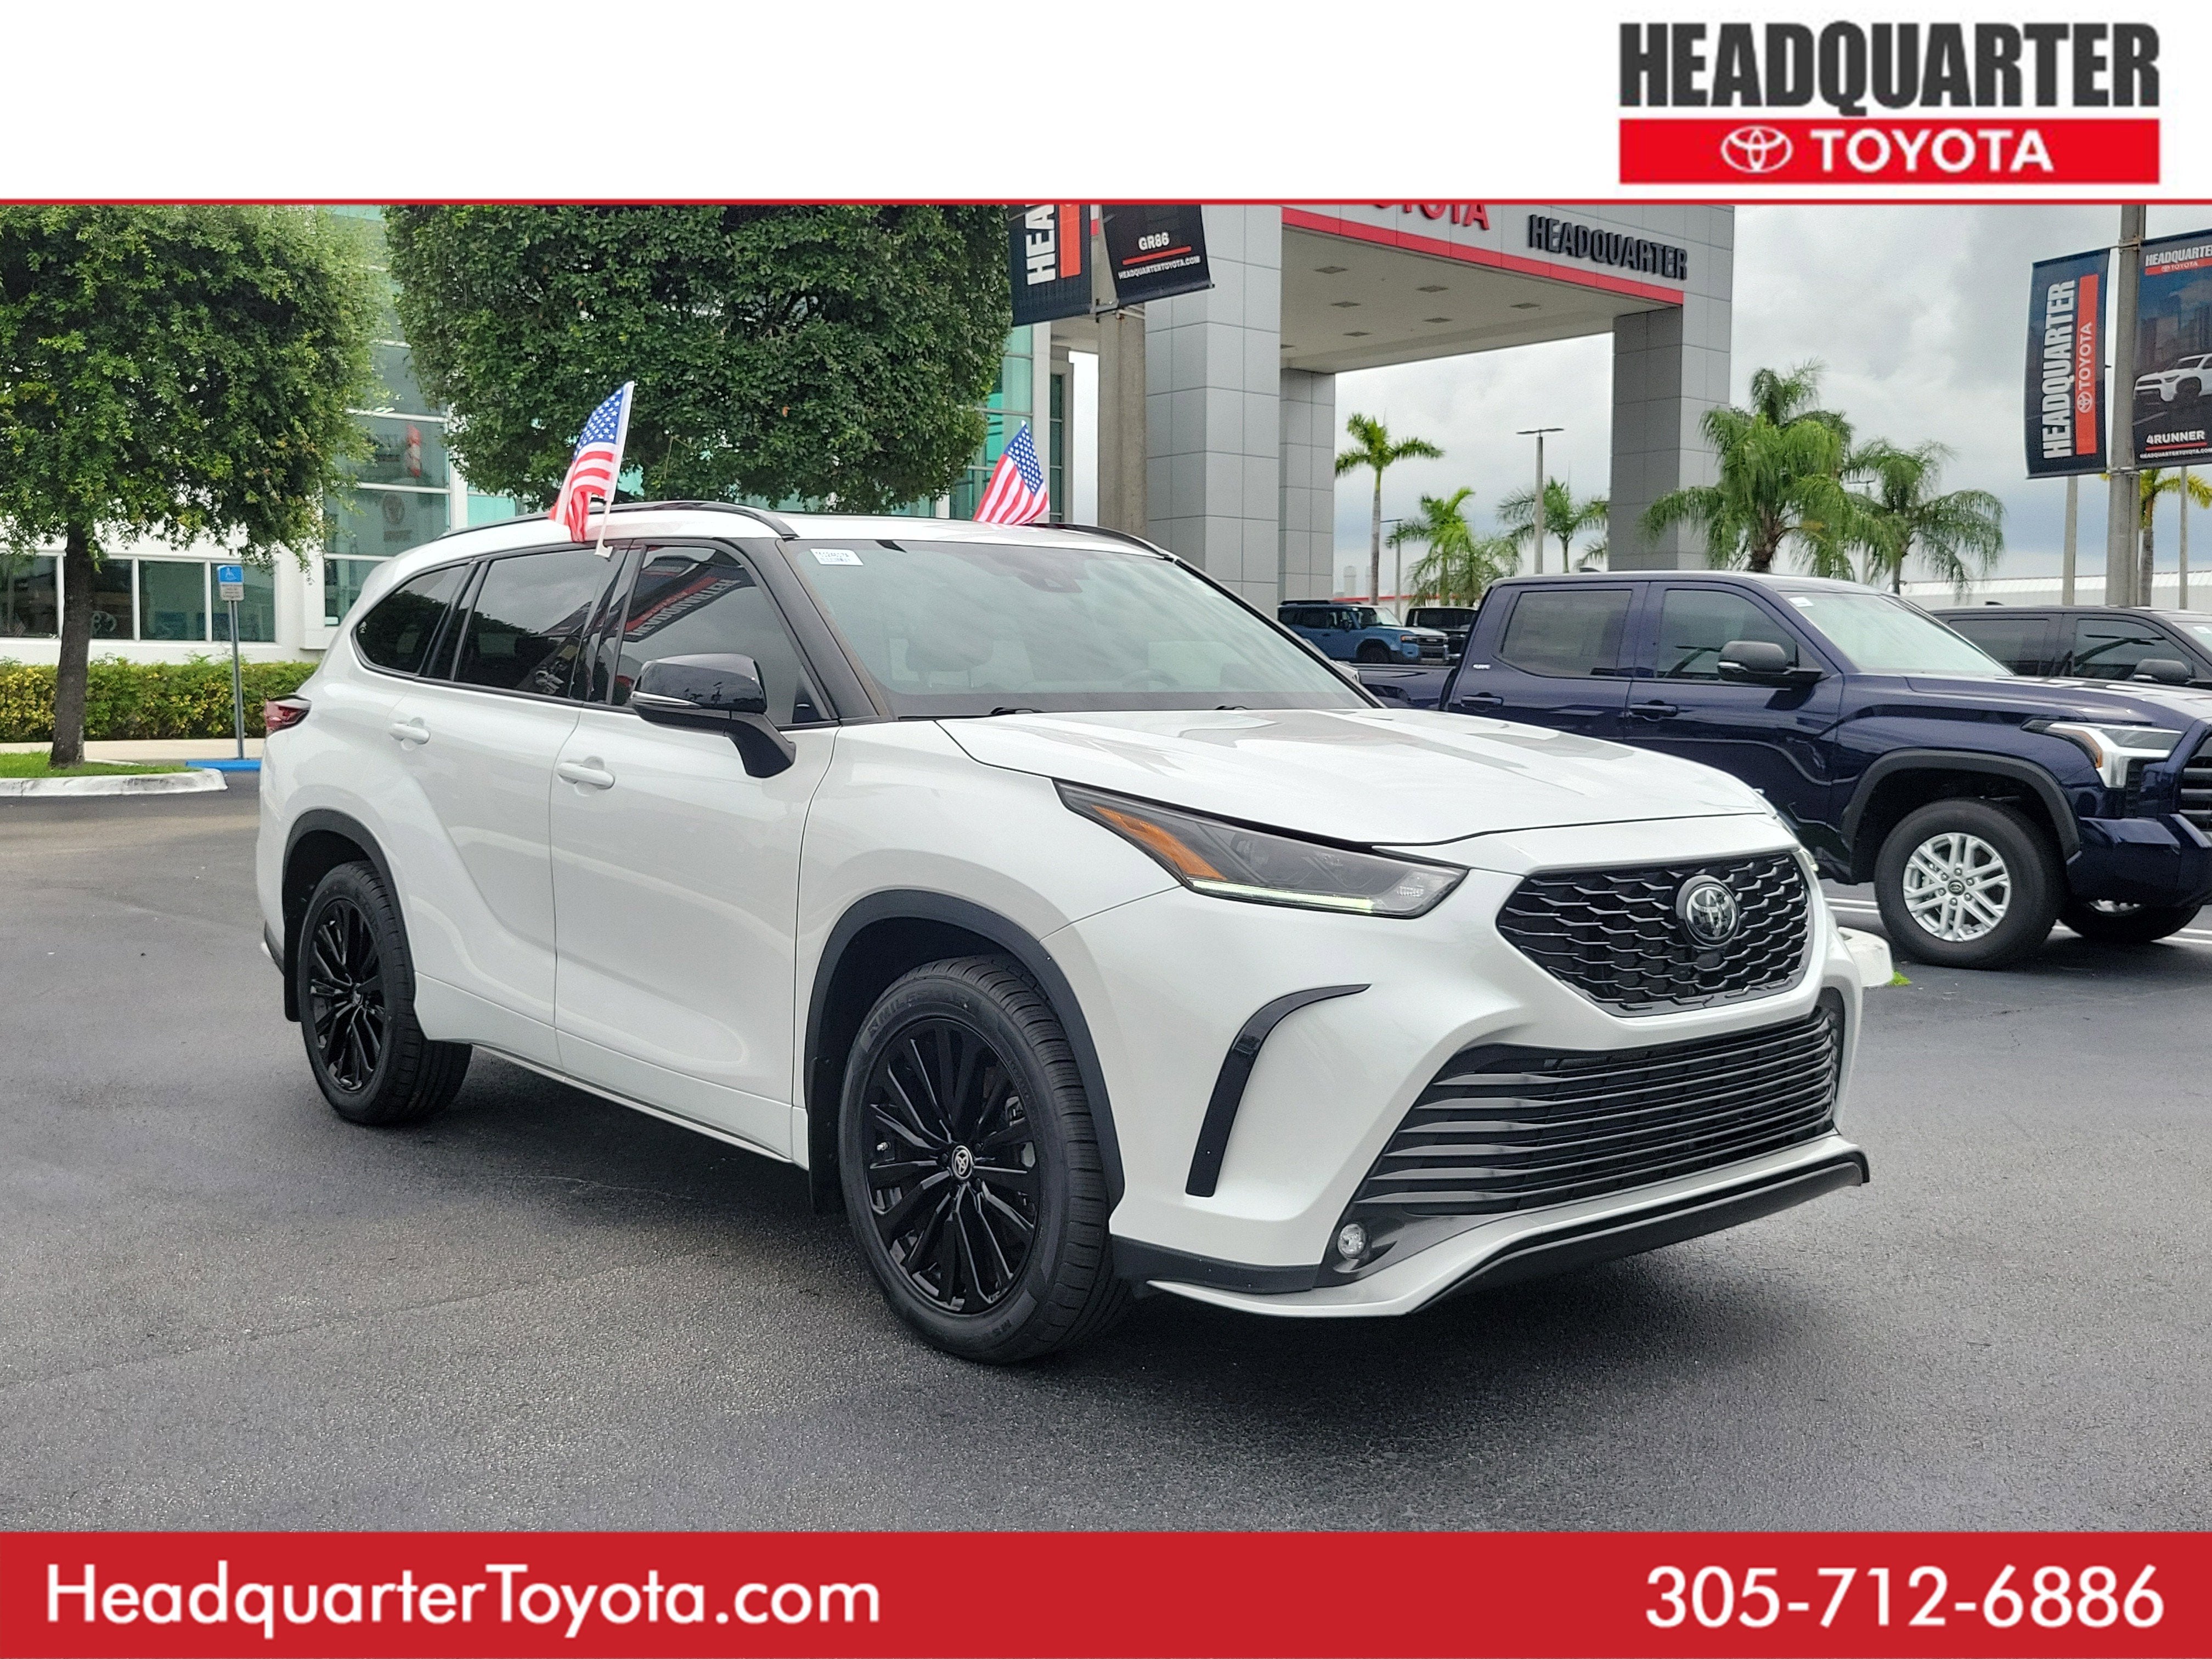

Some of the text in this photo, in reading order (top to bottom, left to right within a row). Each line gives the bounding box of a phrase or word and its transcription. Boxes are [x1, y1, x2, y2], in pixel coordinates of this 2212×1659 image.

[1025, 204, 1056, 285] HEA
[1138, 232, 1170, 251] GR86
[1528, 214, 1688, 280] HEADQUARTER
[2042, 280, 2076, 459] HEADQUARTER
[2079, 321, 2093, 391] TOYOTA
[2146, 430, 2205, 445] 4RUNNER
